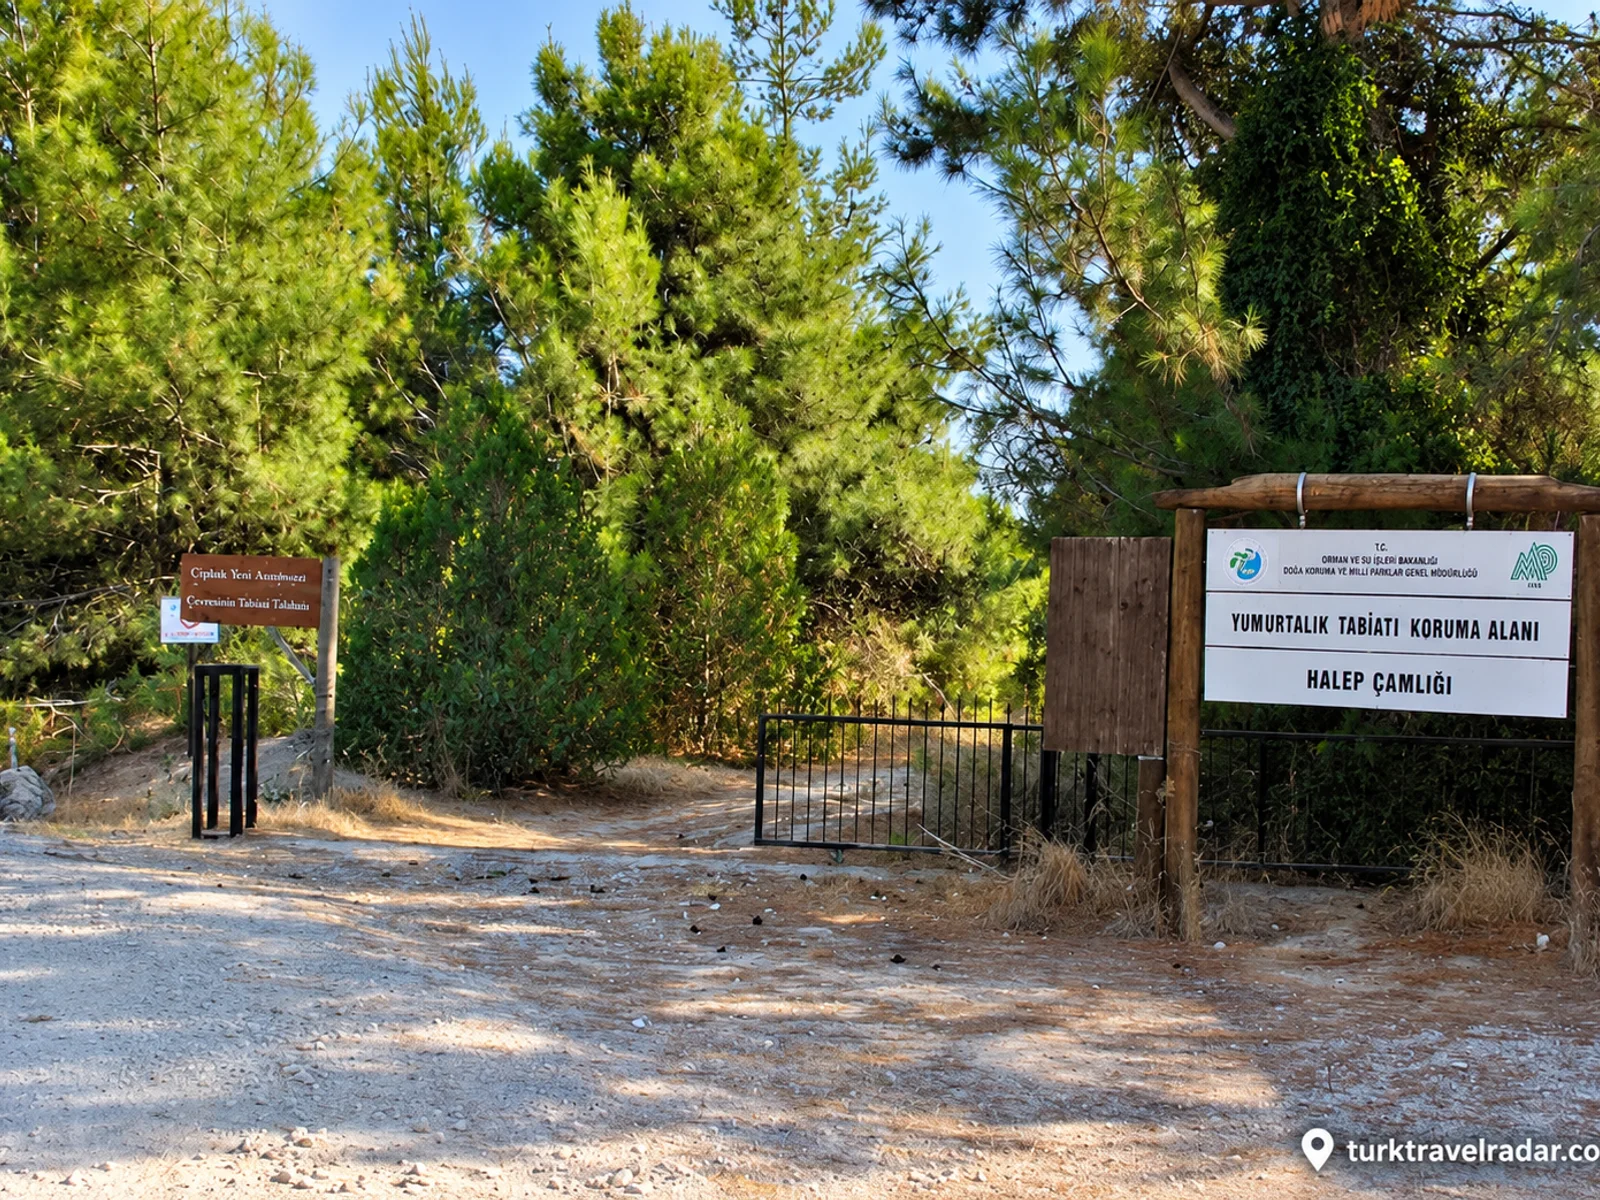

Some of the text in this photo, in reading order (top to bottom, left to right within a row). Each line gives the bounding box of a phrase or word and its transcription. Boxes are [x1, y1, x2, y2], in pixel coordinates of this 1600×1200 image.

[1375, 543, 1388, 552] T.C.
[1321, 555, 1349, 564] ORMAN
[1350, 555, 1360, 564] VE
[1361, 556, 1372, 565] SU
[1283, 565, 1303, 575] DOĞA
[1305, 566, 1336, 575] KORUMA
[1338, 567, 1348, 576] VE
[1370, 567, 1404, 577] PARKLAR
[1405, 568, 1429, 577] GENEL
[1231, 611, 1540, 642] YUMURTALIK TABİATI KORUMA ALANI
[1307, 669, 1452, 697] HALEP ÇAMLIĞI
